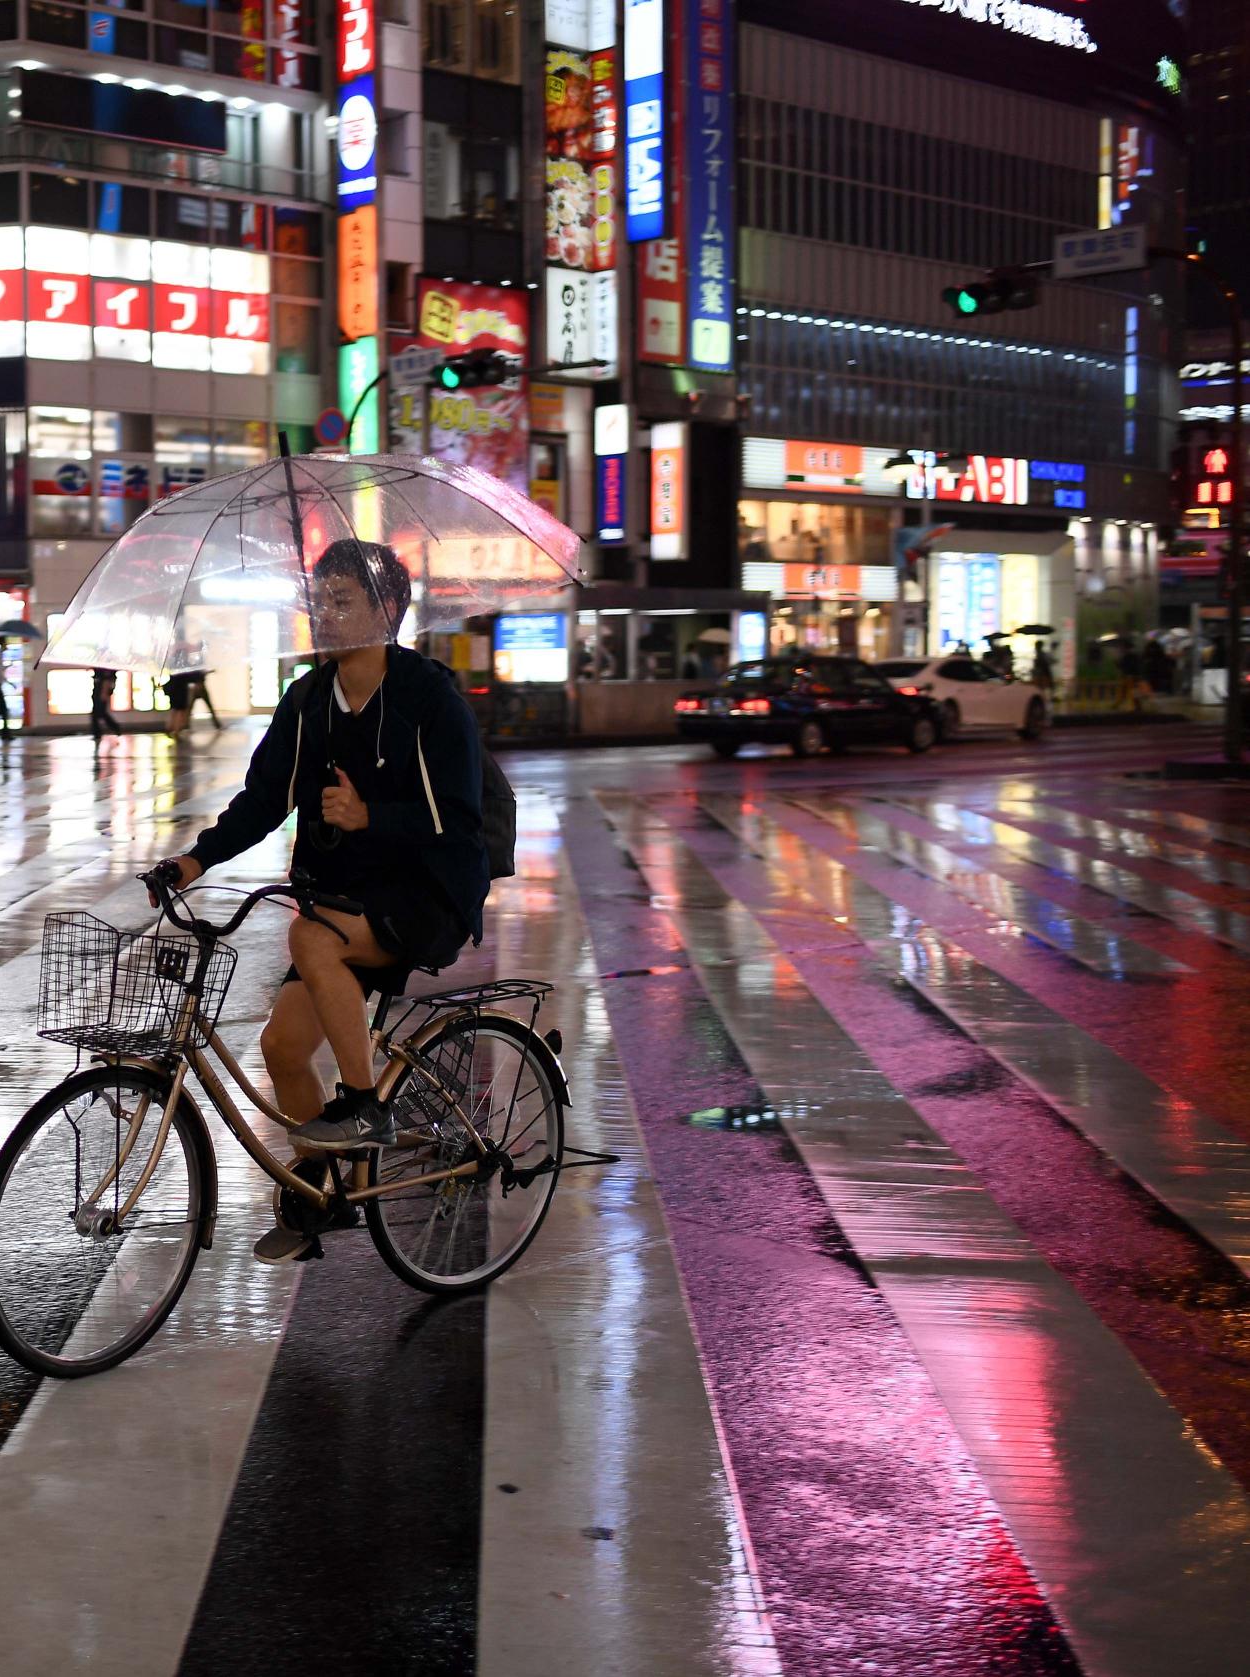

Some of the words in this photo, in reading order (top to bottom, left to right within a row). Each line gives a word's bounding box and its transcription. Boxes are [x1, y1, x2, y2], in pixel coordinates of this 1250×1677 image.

[341, 0, 371, 73] フル
[628, 136, 662, 217] LABI
[699, 95, 725, 314] リフォーム提案
[42, 279, 260, 337] アイフル
